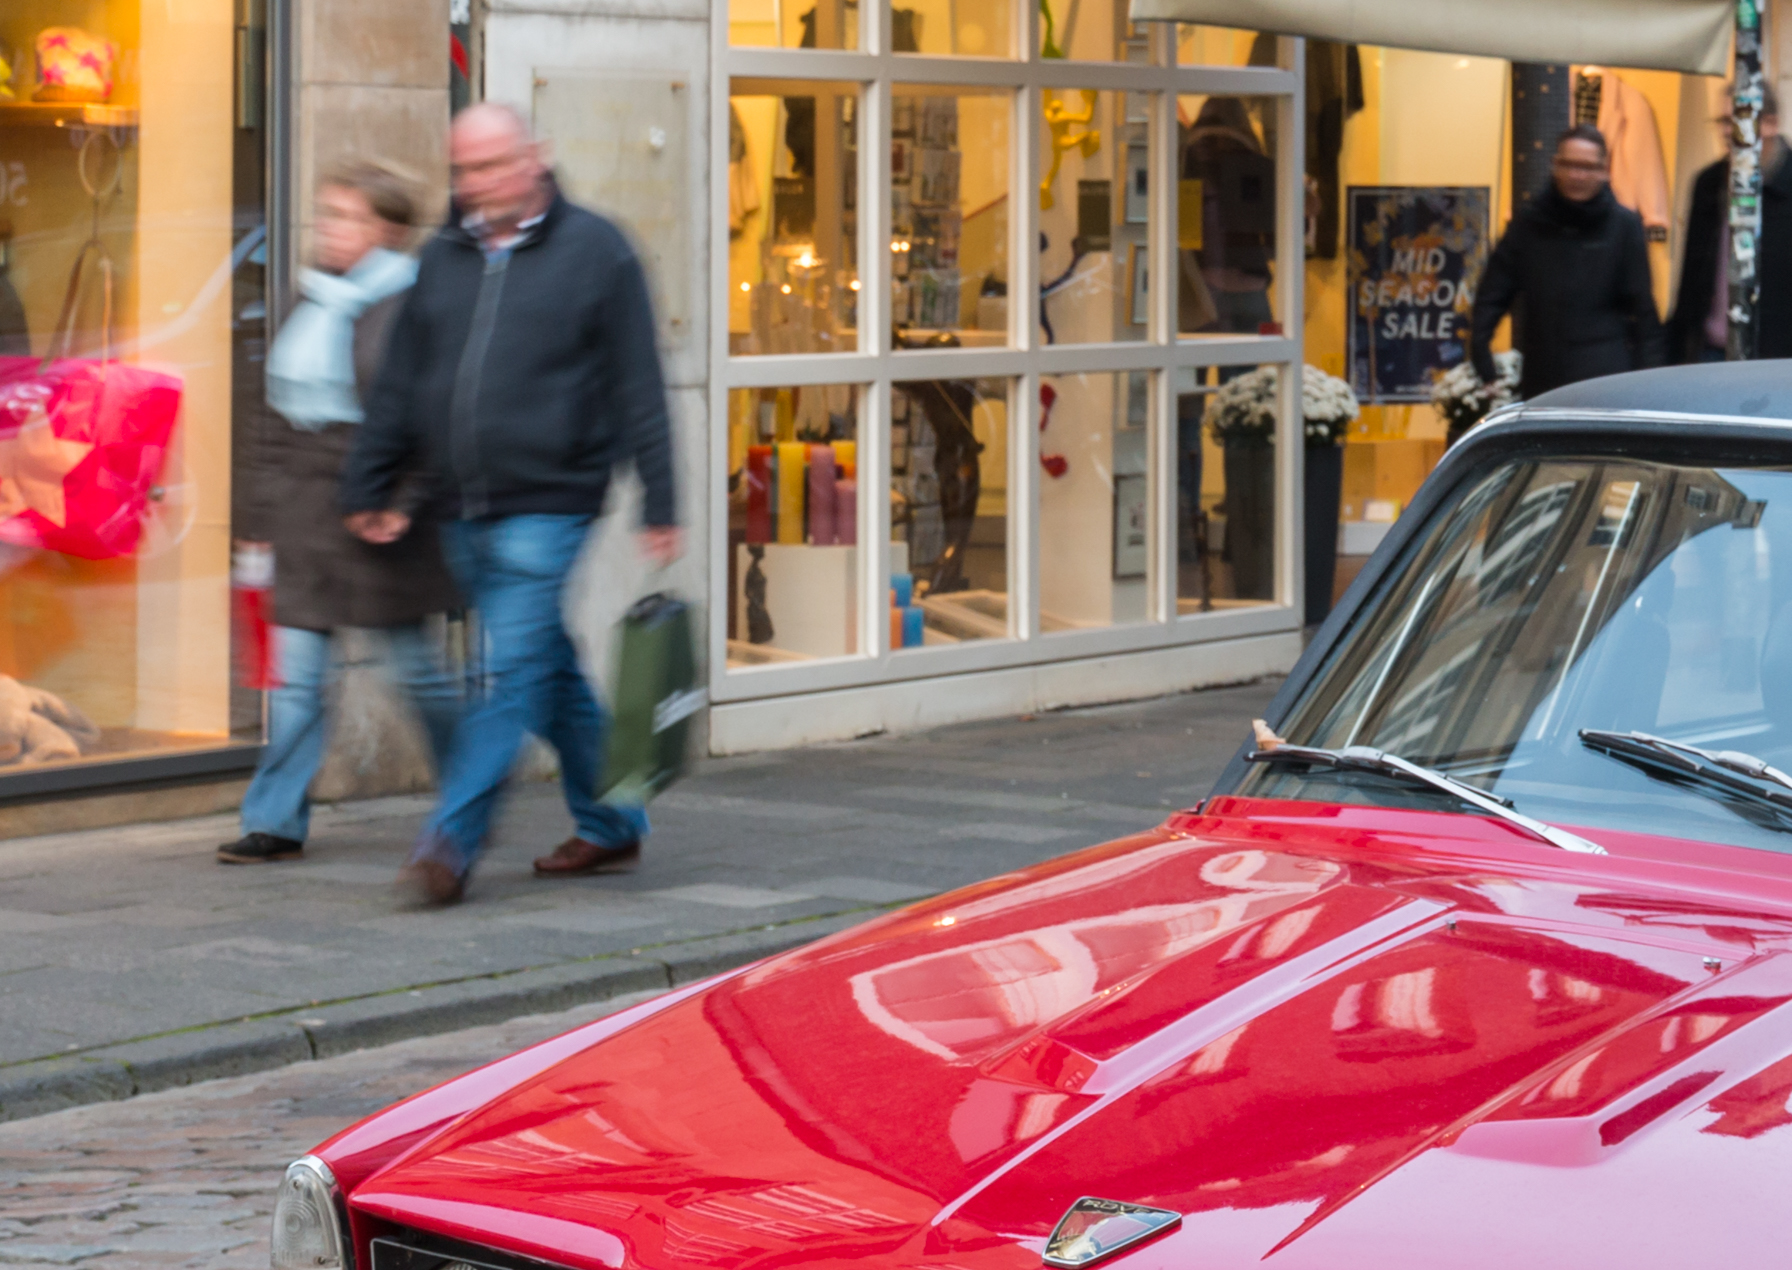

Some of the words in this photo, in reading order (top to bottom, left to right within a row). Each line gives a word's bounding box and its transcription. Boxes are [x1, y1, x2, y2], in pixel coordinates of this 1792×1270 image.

[1392, 248, 1446, 274] MID
[1359, 280, 1475, 307] SEASON
[1381, 312, 1456, 339] SALE
